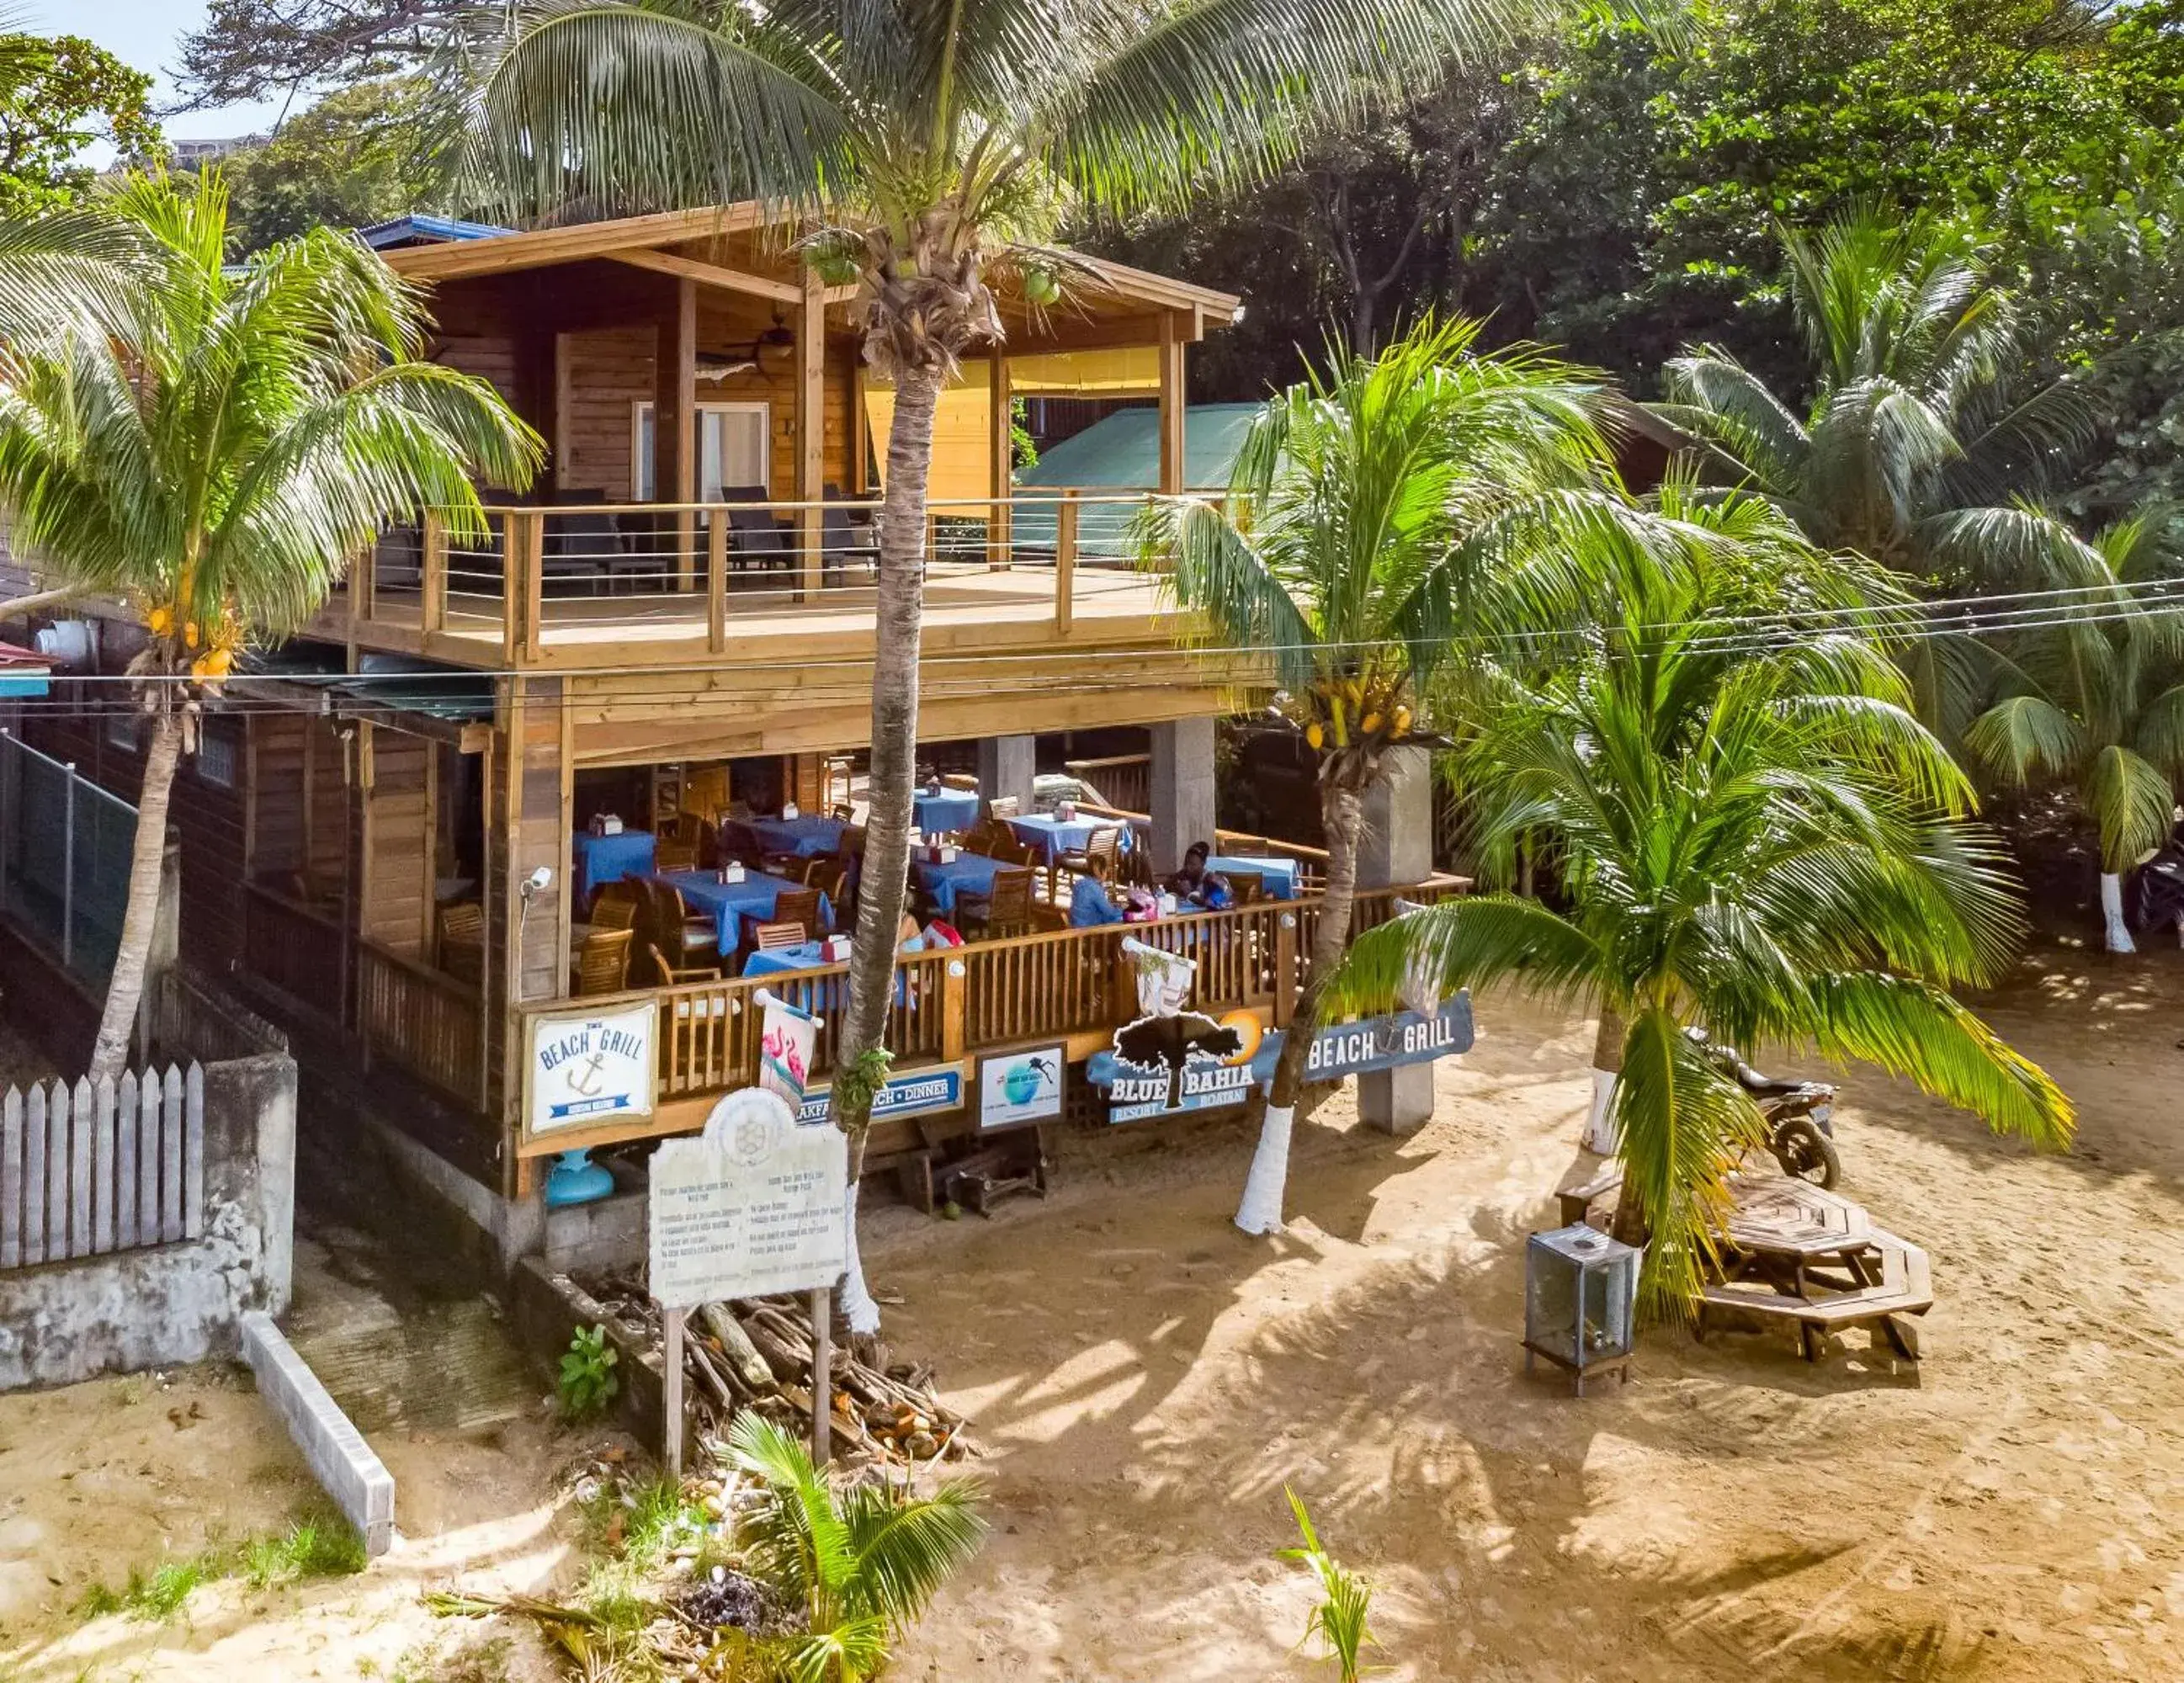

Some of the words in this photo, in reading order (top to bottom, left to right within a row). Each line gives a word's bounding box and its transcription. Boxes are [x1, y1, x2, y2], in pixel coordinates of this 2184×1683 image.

[539, 1032, 589, 1070] BEACH
[599, 1028, 642, 1060] GRILL
[1308, 1031, 1375, 1070] BEACH
[1404, 1017, 1455, 1054] GRILL
[905, 1082, 949, 1101] DINNER
[1109, 1078, 1168, 1102] BLUE
[1185, 1064, 1255, 1094] BAHIA
[1115, 1102, 1159, 1122] RESORT
